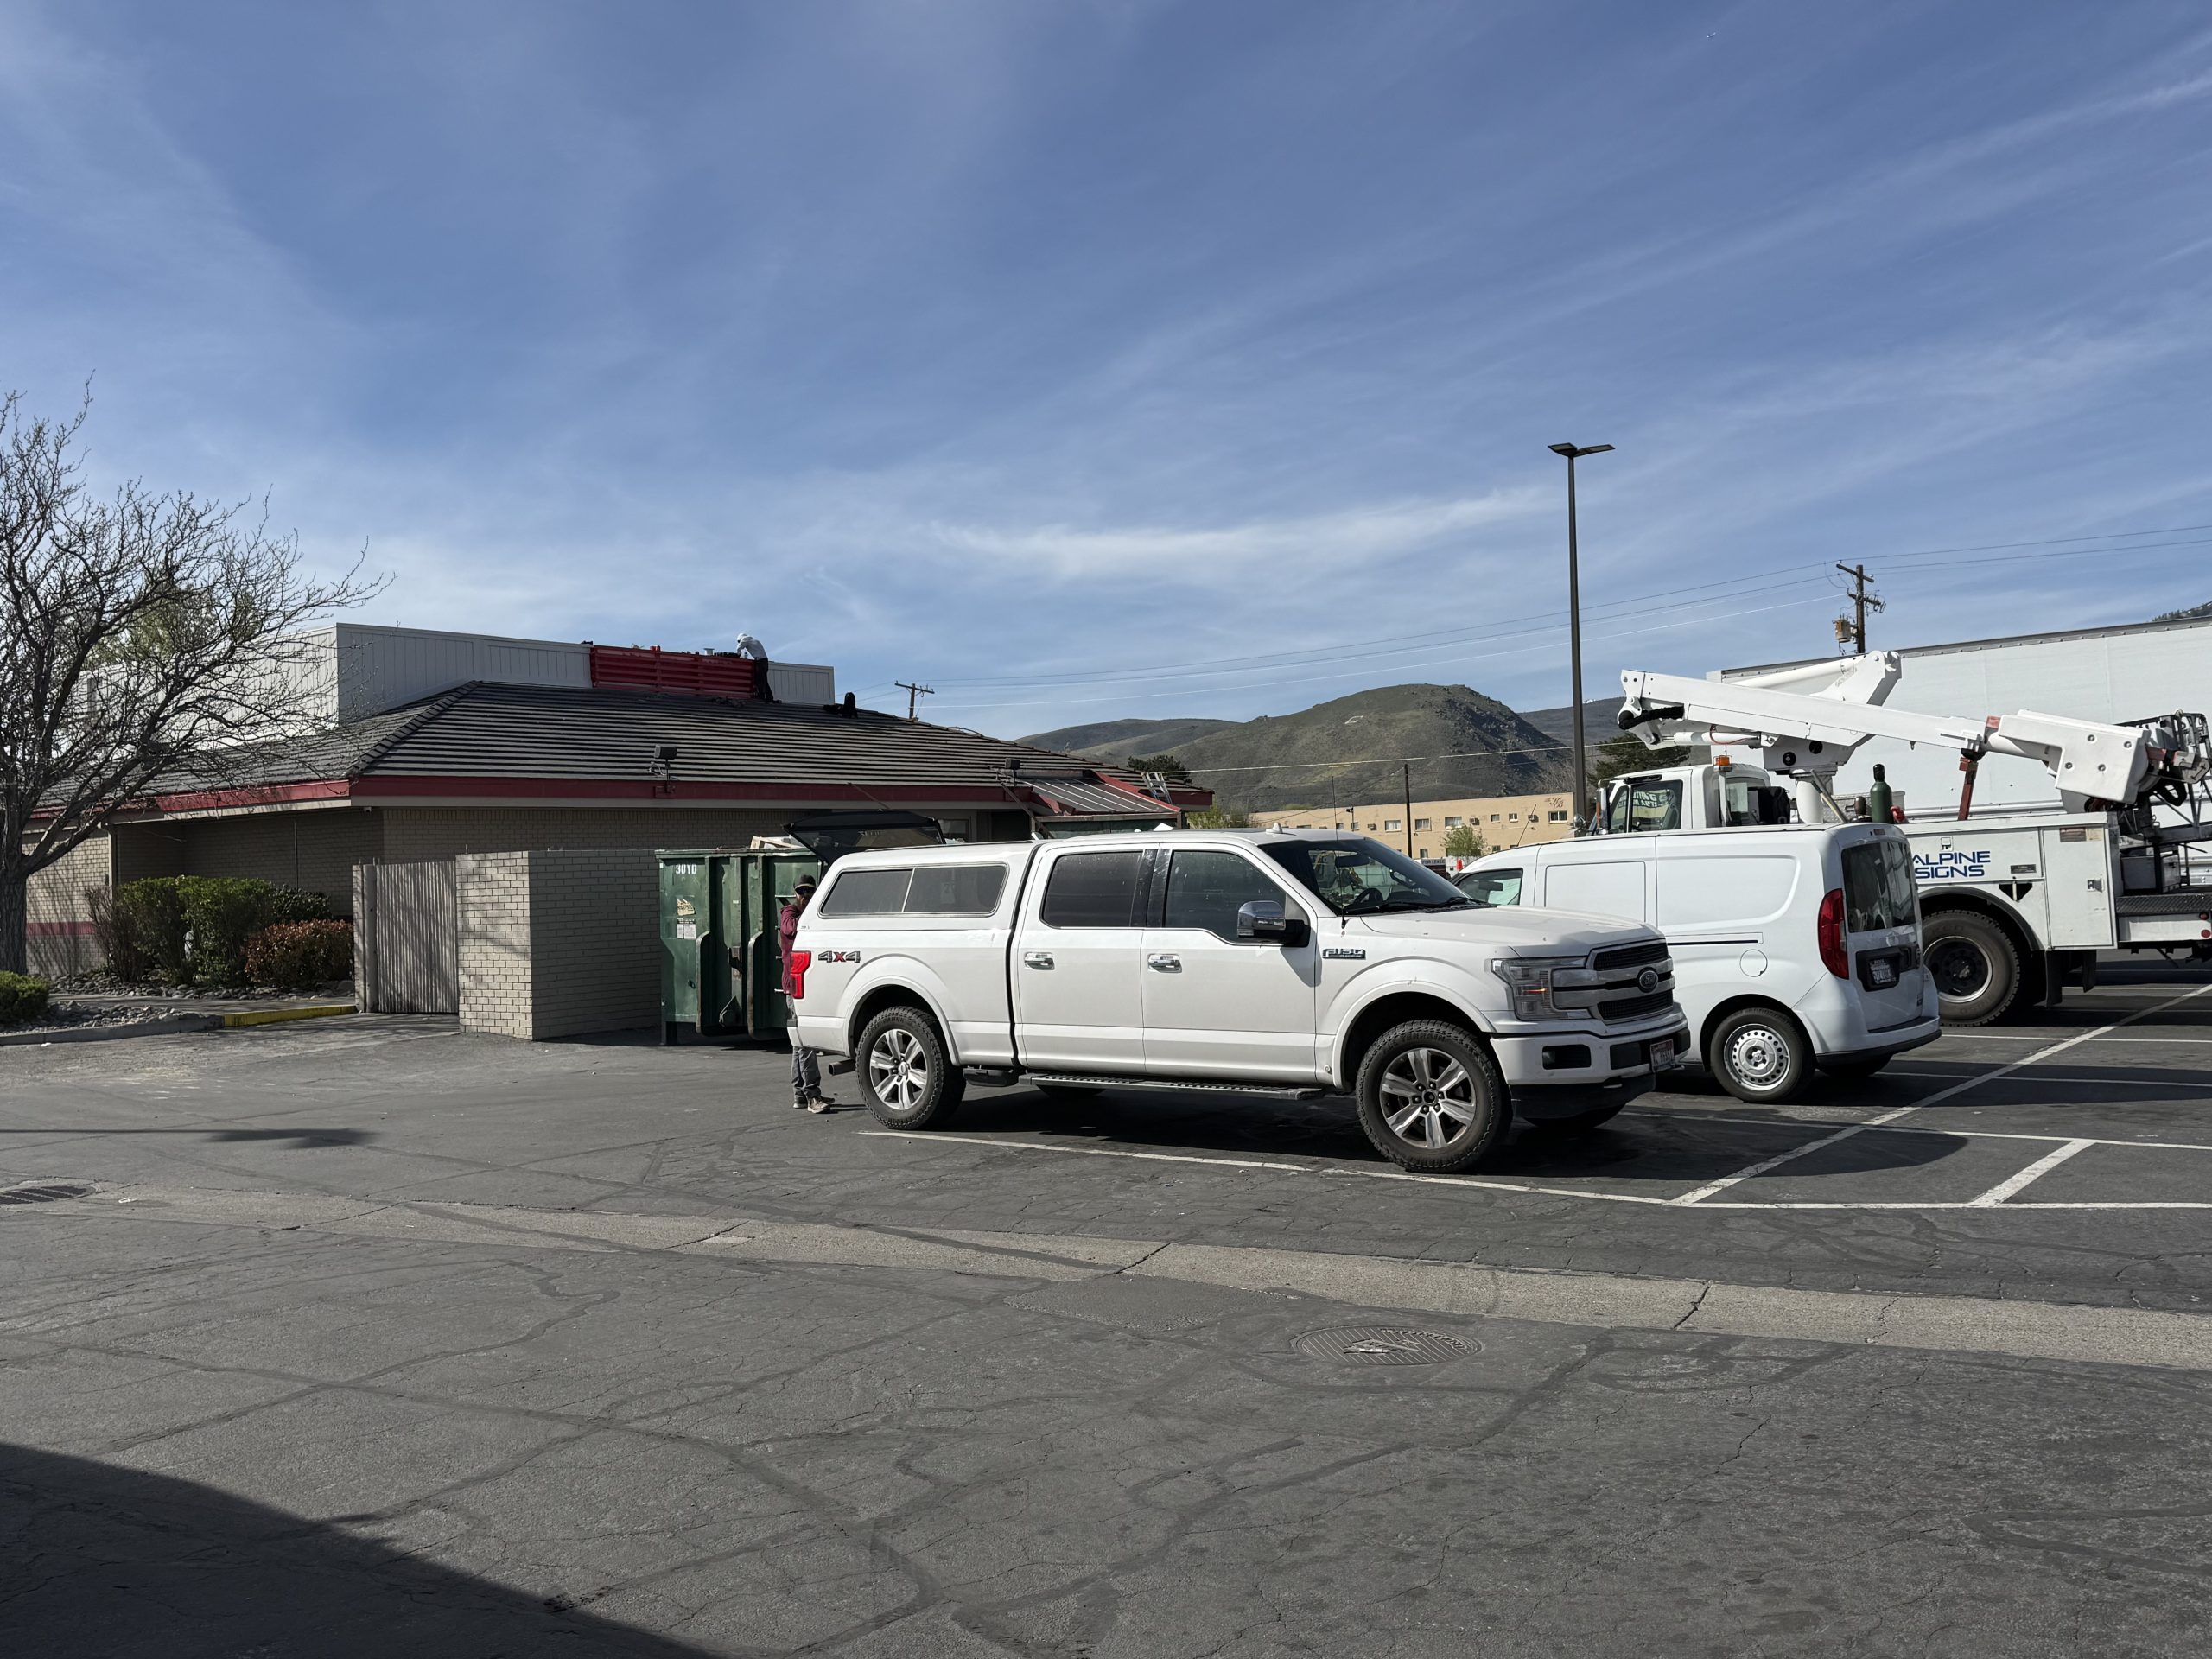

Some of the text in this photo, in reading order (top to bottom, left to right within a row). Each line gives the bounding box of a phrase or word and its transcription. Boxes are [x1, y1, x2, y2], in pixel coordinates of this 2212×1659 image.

[1912, 851, 1991, 866] ALPINE
[676, 864, 697, 874] 30YD
[1914, 864, 1985, 879] SIGNS
